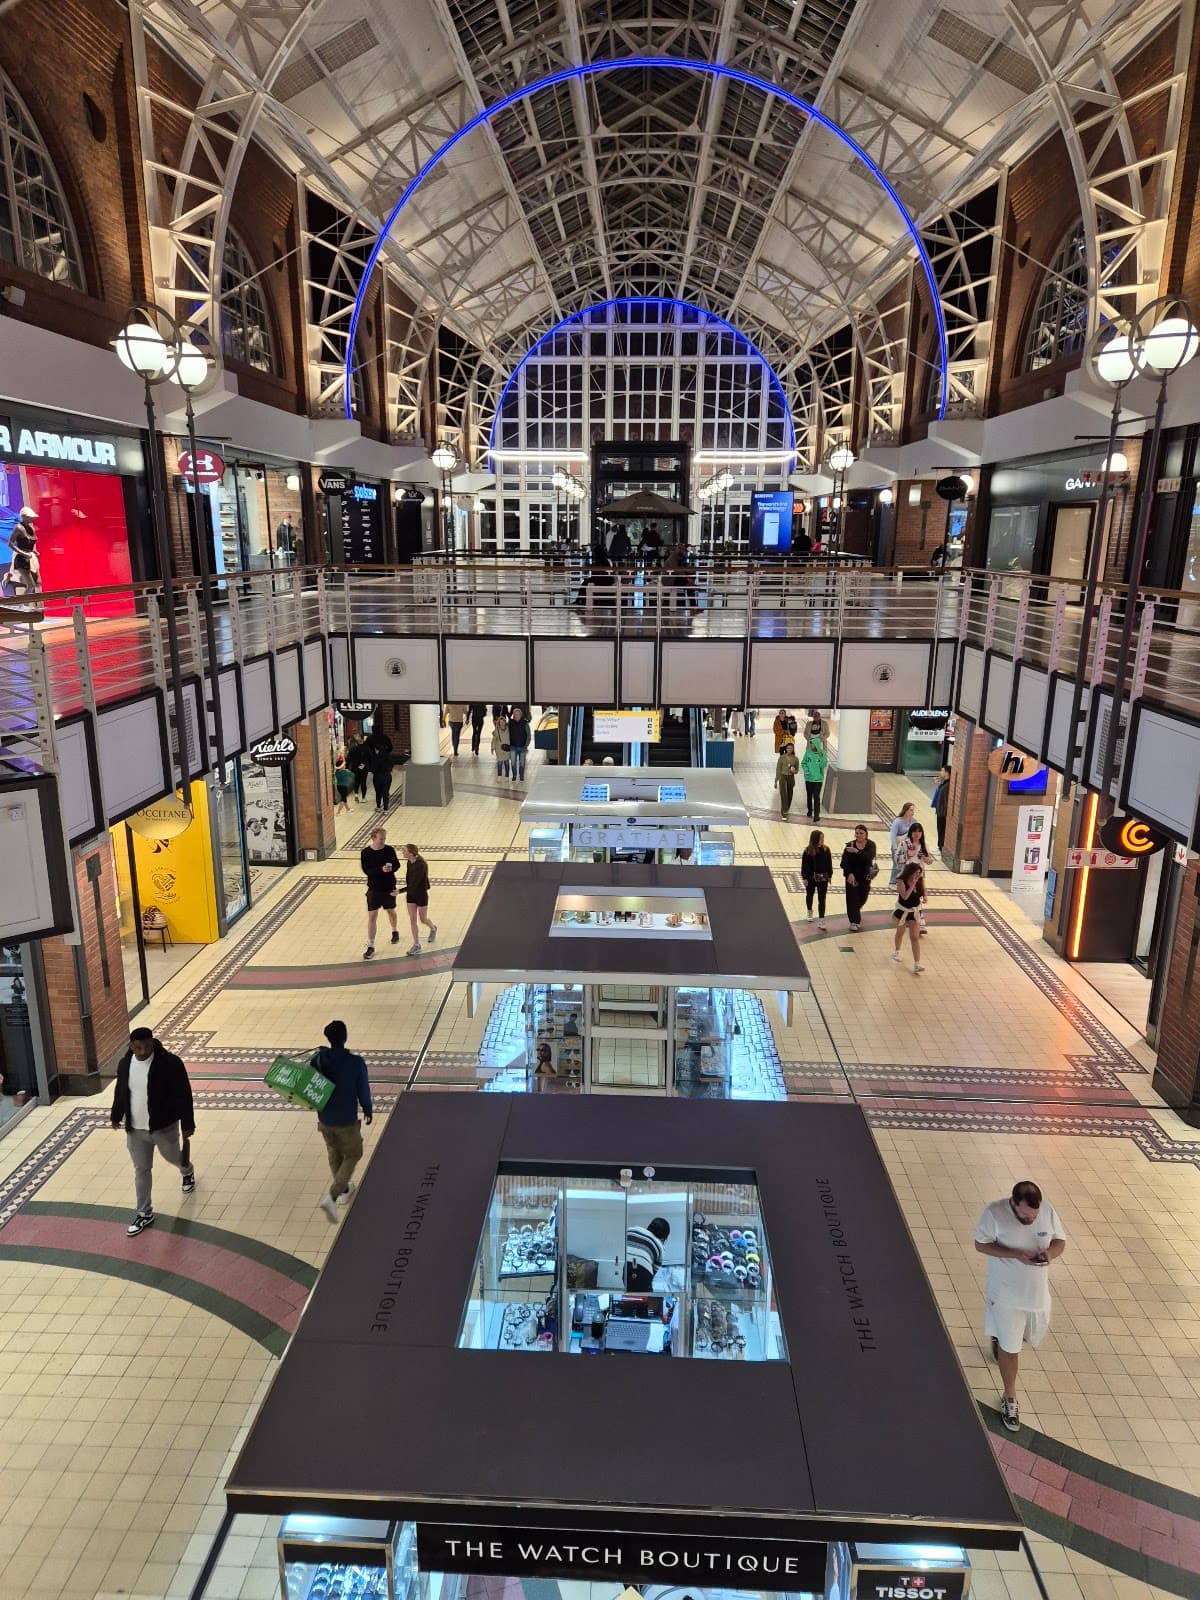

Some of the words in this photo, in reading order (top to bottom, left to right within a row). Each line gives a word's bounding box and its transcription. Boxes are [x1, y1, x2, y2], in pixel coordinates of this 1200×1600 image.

[18, 429, 116, 466] ARMOUR
[320, 479, 346, 489] VANS
[250, 738, 295, 754] Kiehl's
[136, 807, 188, 819] OCCITANE
[579, 830, 687, 846] GRATIAE
[310, 1071, 327, 1090] Bolt
[303, 1083, 325, 1104] Food
[420, 1163, 440, 1188] THE
[402, 1193, 431, 1241] WATCH
[815, 1177, 848, 1248] BOUTIQUE
[371, 1247, 413, 1333] BOUTIQUE
[836, 1254, 865, 1310] WATCH
[853, 1317, 877, 1353] THE
[445, 1540, 504, 1560] THE
[518, 1543, 623, 1565] WATCH
[640, 1550, 800, 1574] BOUTIQUE
[875, 1586, 947, 1600] TISSOT
